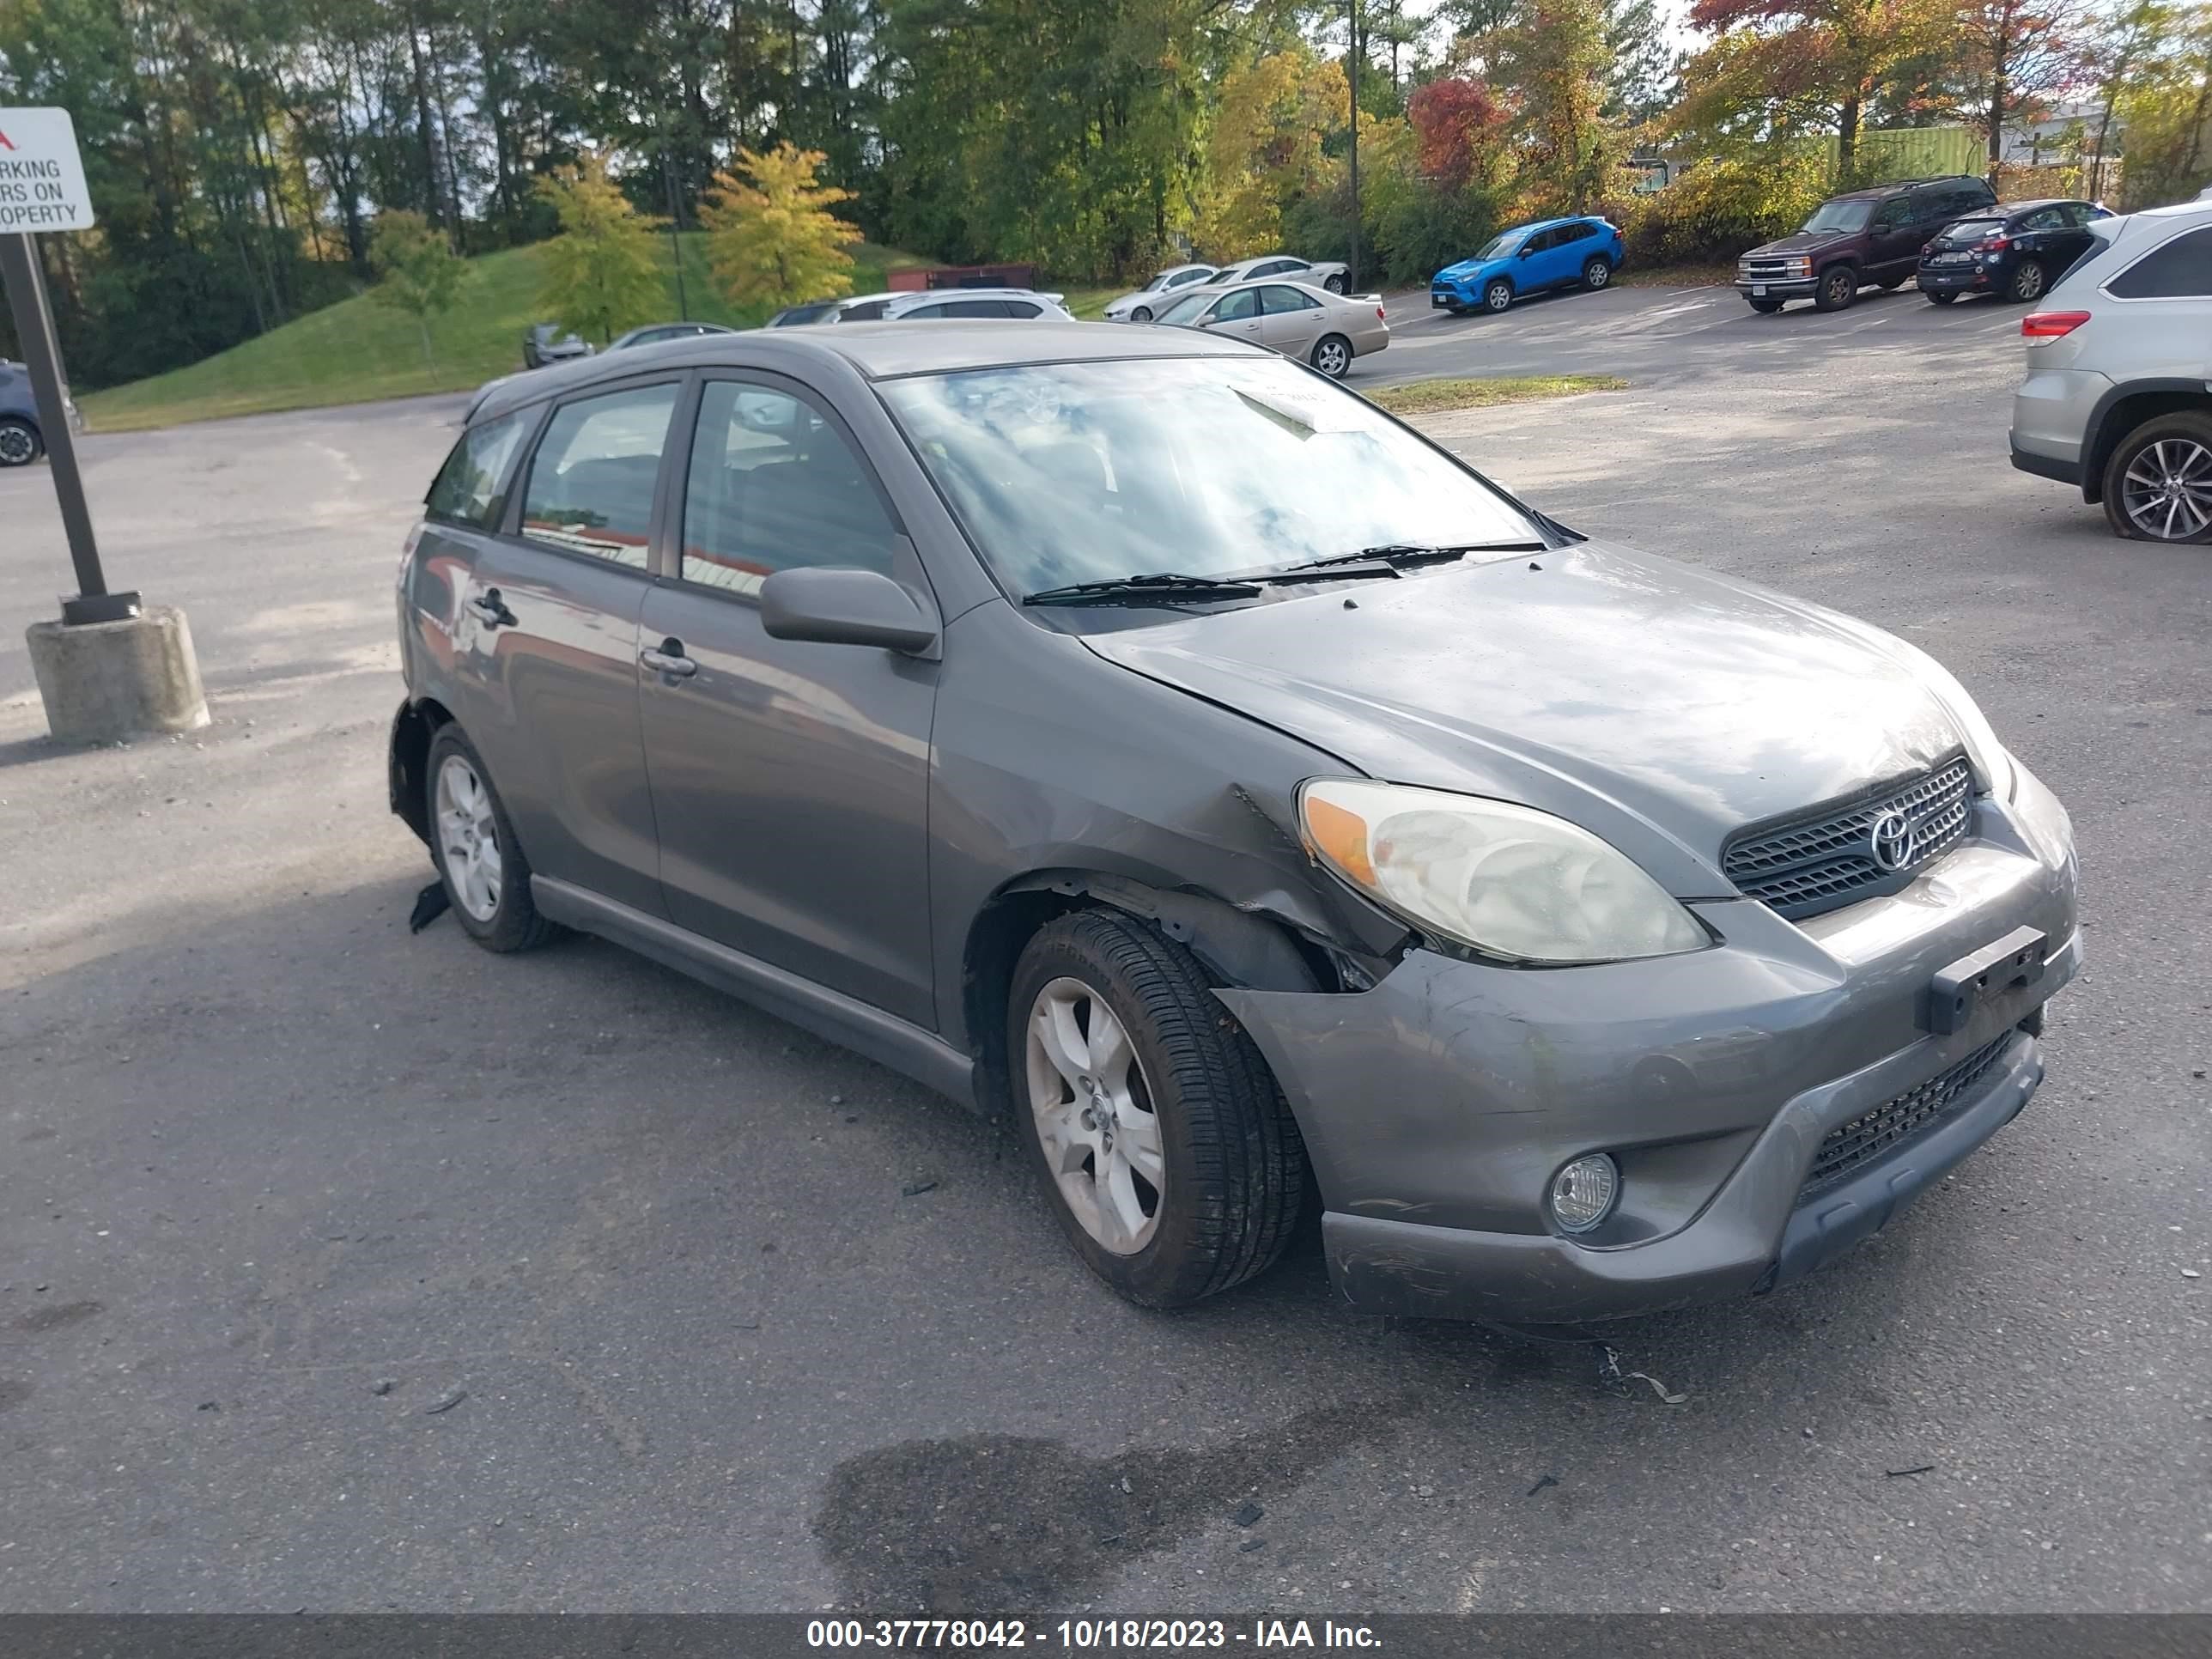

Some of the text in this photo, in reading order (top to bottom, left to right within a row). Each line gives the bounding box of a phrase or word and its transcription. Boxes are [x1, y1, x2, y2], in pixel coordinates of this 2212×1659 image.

[0, 182, 63, 202] RS ON
[0, 204, 76, 225] OPERTY
